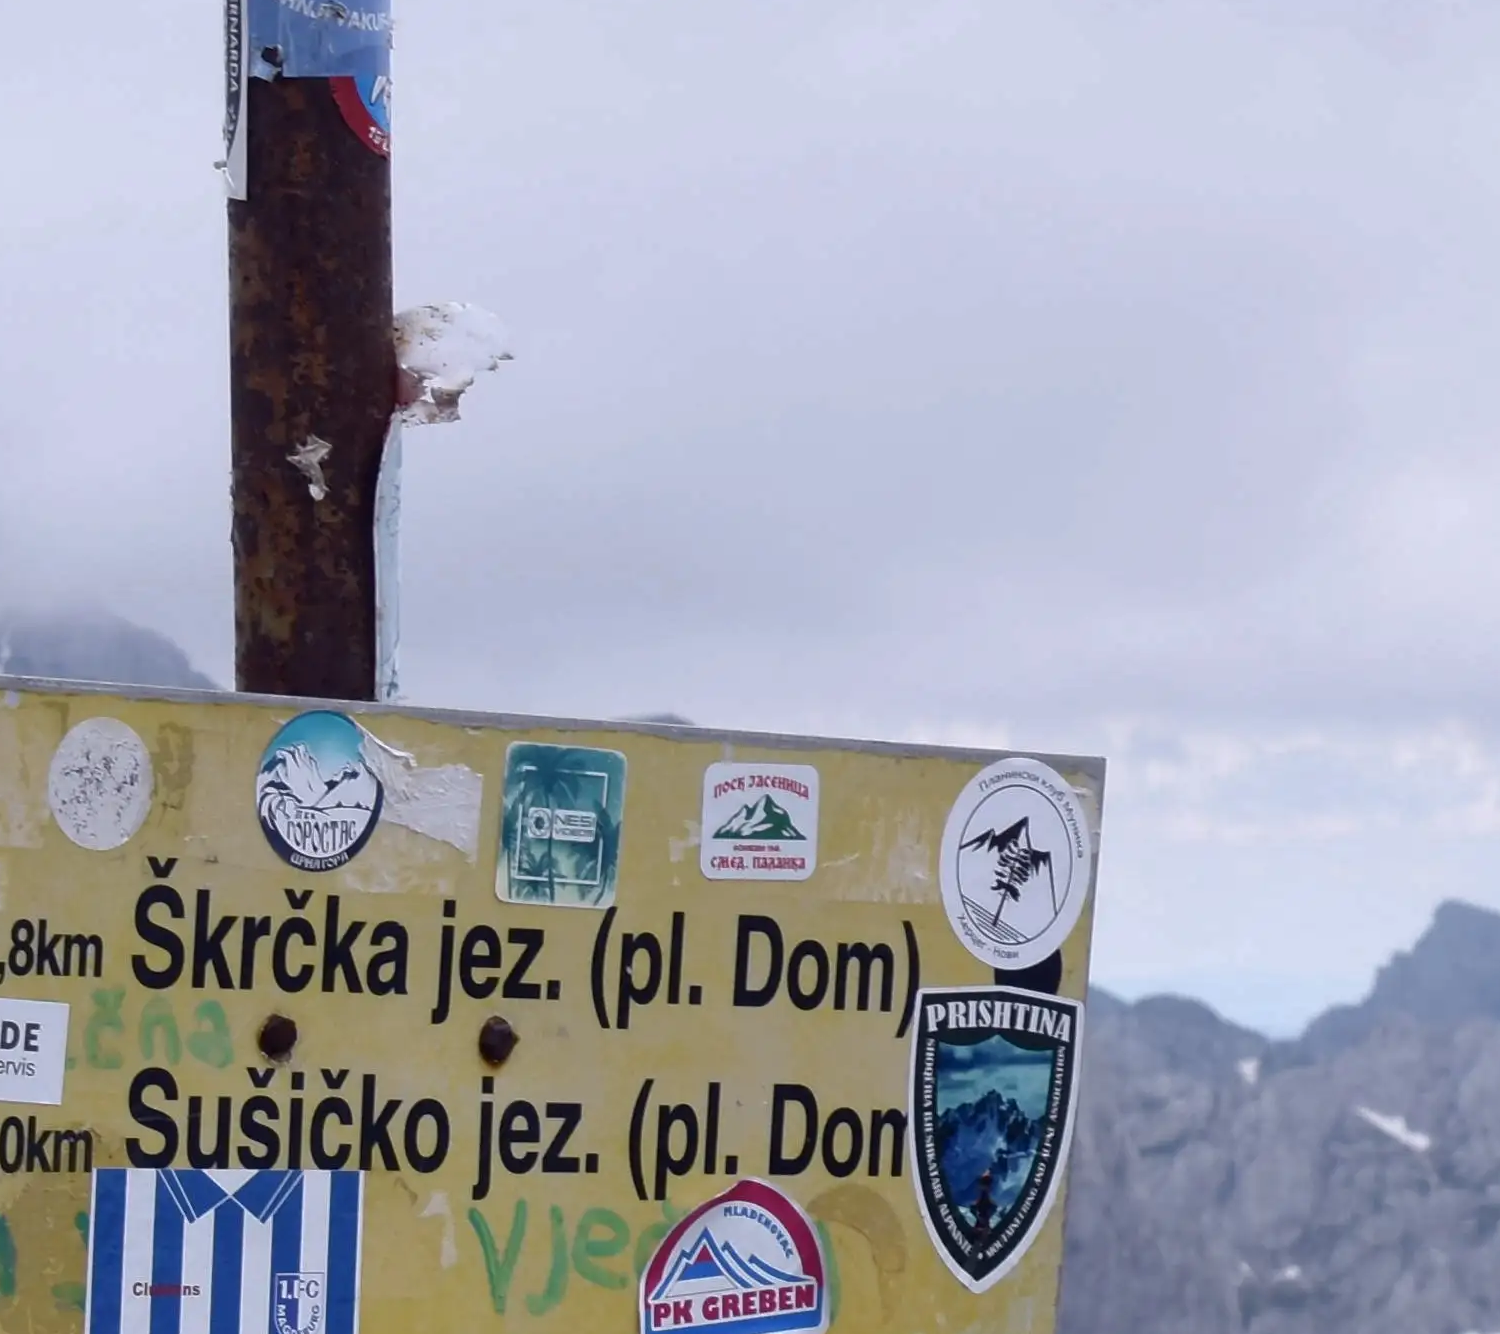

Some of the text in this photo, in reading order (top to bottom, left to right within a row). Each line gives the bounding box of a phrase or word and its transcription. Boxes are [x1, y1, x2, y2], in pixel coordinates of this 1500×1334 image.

[130, 855, 410, 995] Škrčka
[430, 899, 562, 1025] jez.
[590, 905, 703, 1030] (pl.
[731, 913, 921, 1039] Dom)
[925, 999, 1072, 1043] PRISHTINA
[124, 1066, 451, 1174] Sušičko
[471, 1076, 600, 1201] jez.
[627, 1078, 740, 1201] (pl.
[723, 1205, 795, 1260] MLADENOVAC
[653, 1283, 815, 1328] PK GREBEN
